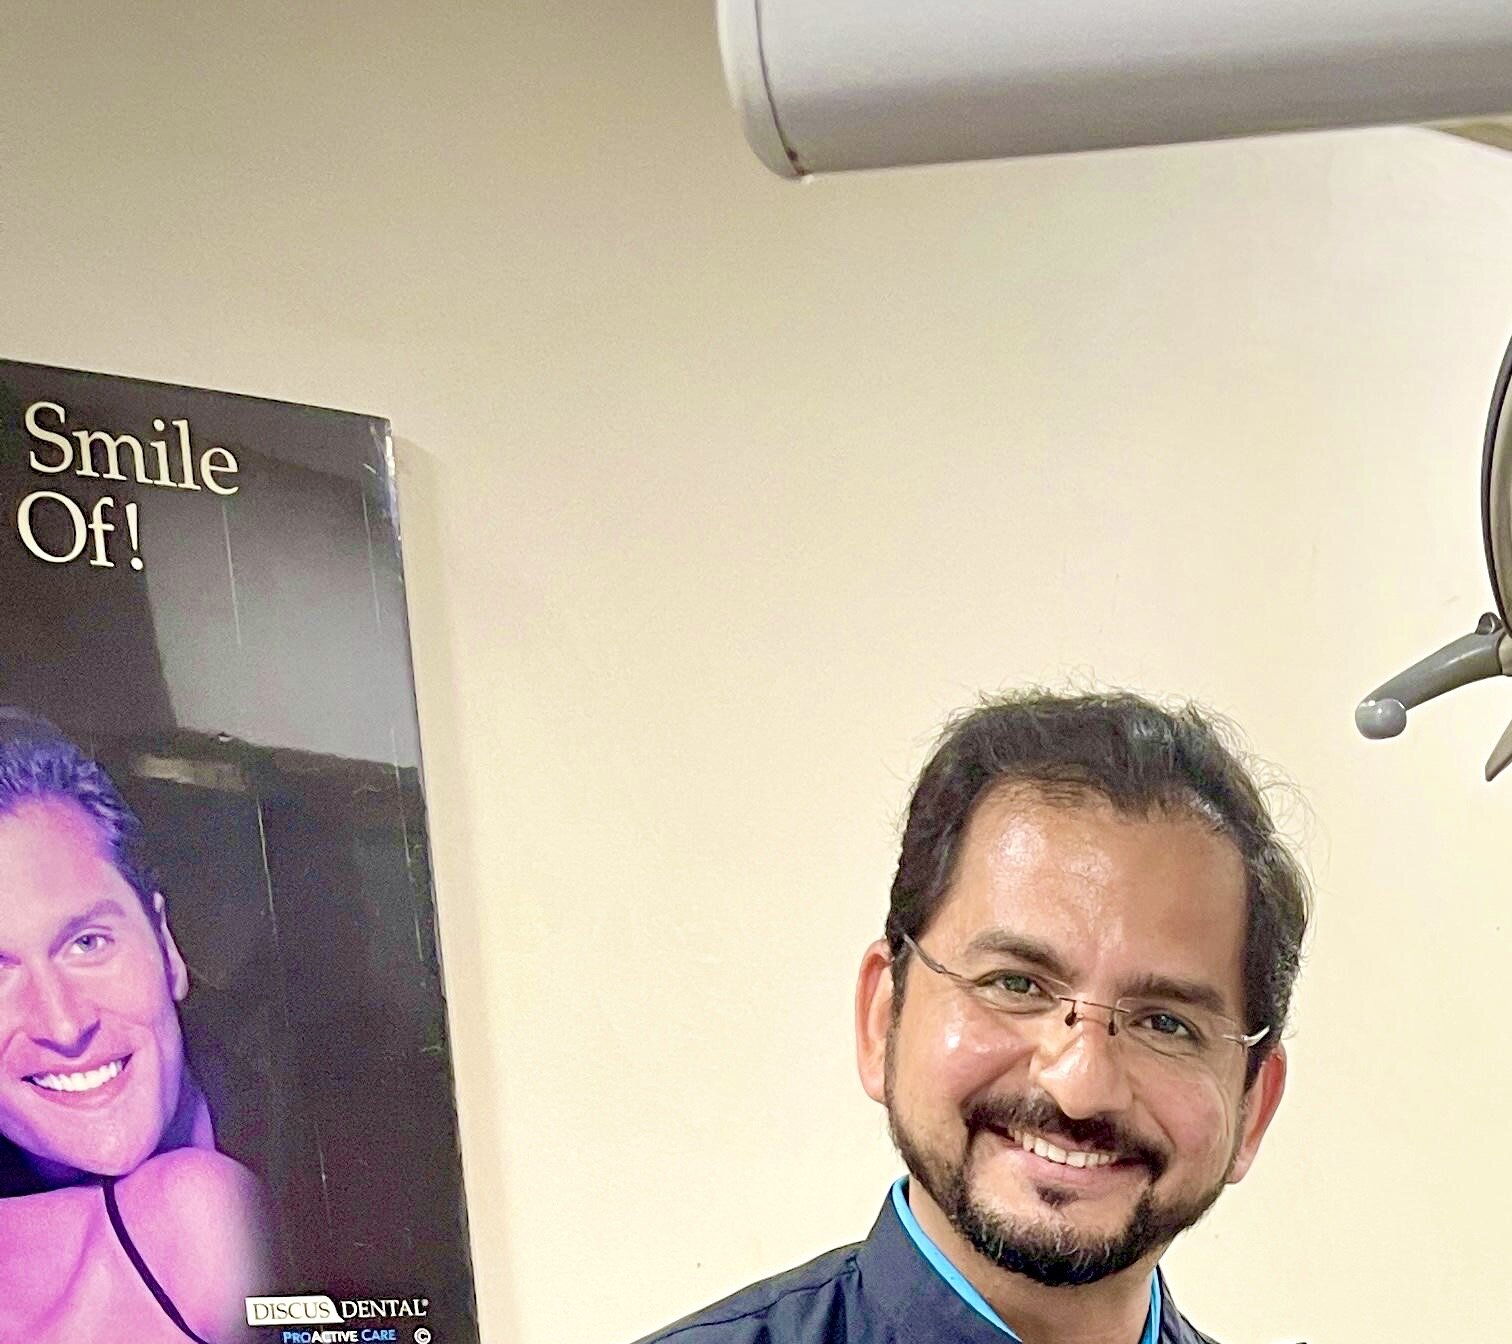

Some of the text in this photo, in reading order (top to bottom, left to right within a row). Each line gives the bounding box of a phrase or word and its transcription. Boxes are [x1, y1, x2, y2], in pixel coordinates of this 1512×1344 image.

[24, 400, 240, 496] Smile
[17, 490, 144, 571] Of!
[253, 1301, 331, 1321] DISCUS
[361, 1329, 397, 1342] CARE
